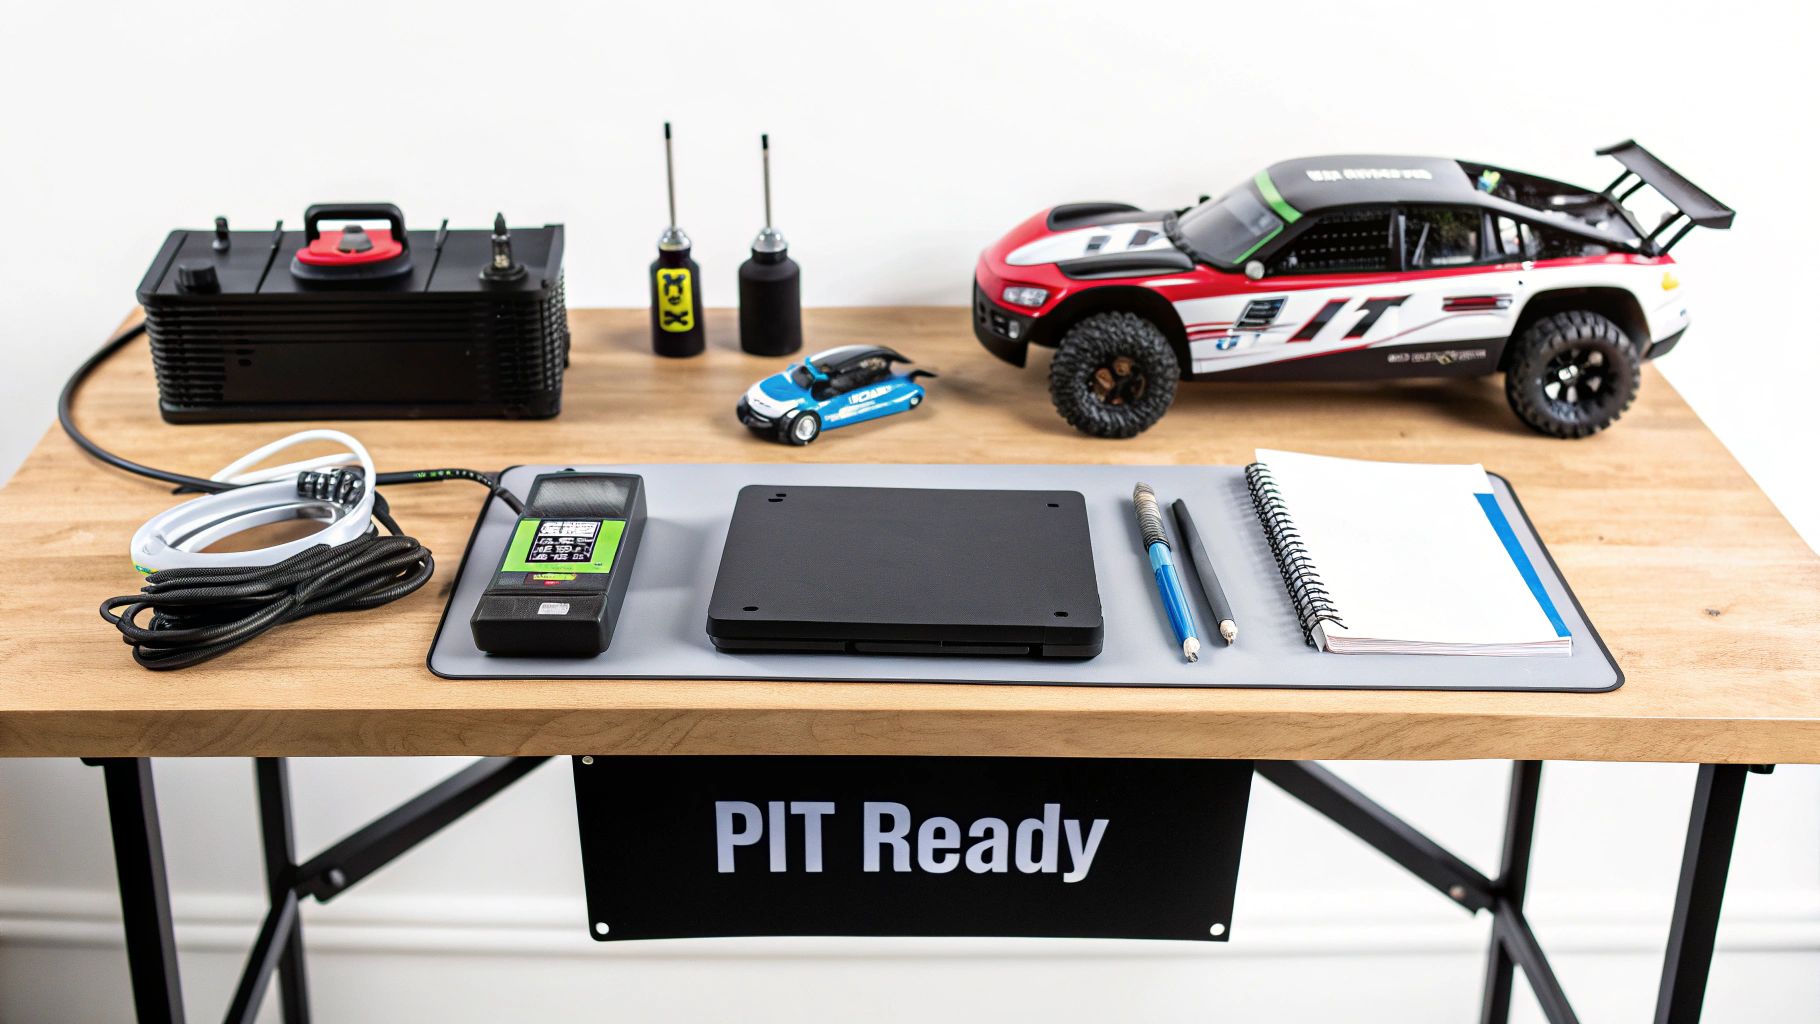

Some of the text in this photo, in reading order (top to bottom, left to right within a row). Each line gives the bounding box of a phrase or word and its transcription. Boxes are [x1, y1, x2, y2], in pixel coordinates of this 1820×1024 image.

[1286, 294, 1413, 343] IT
[715, 801, 1110, 884] PIT Ready
